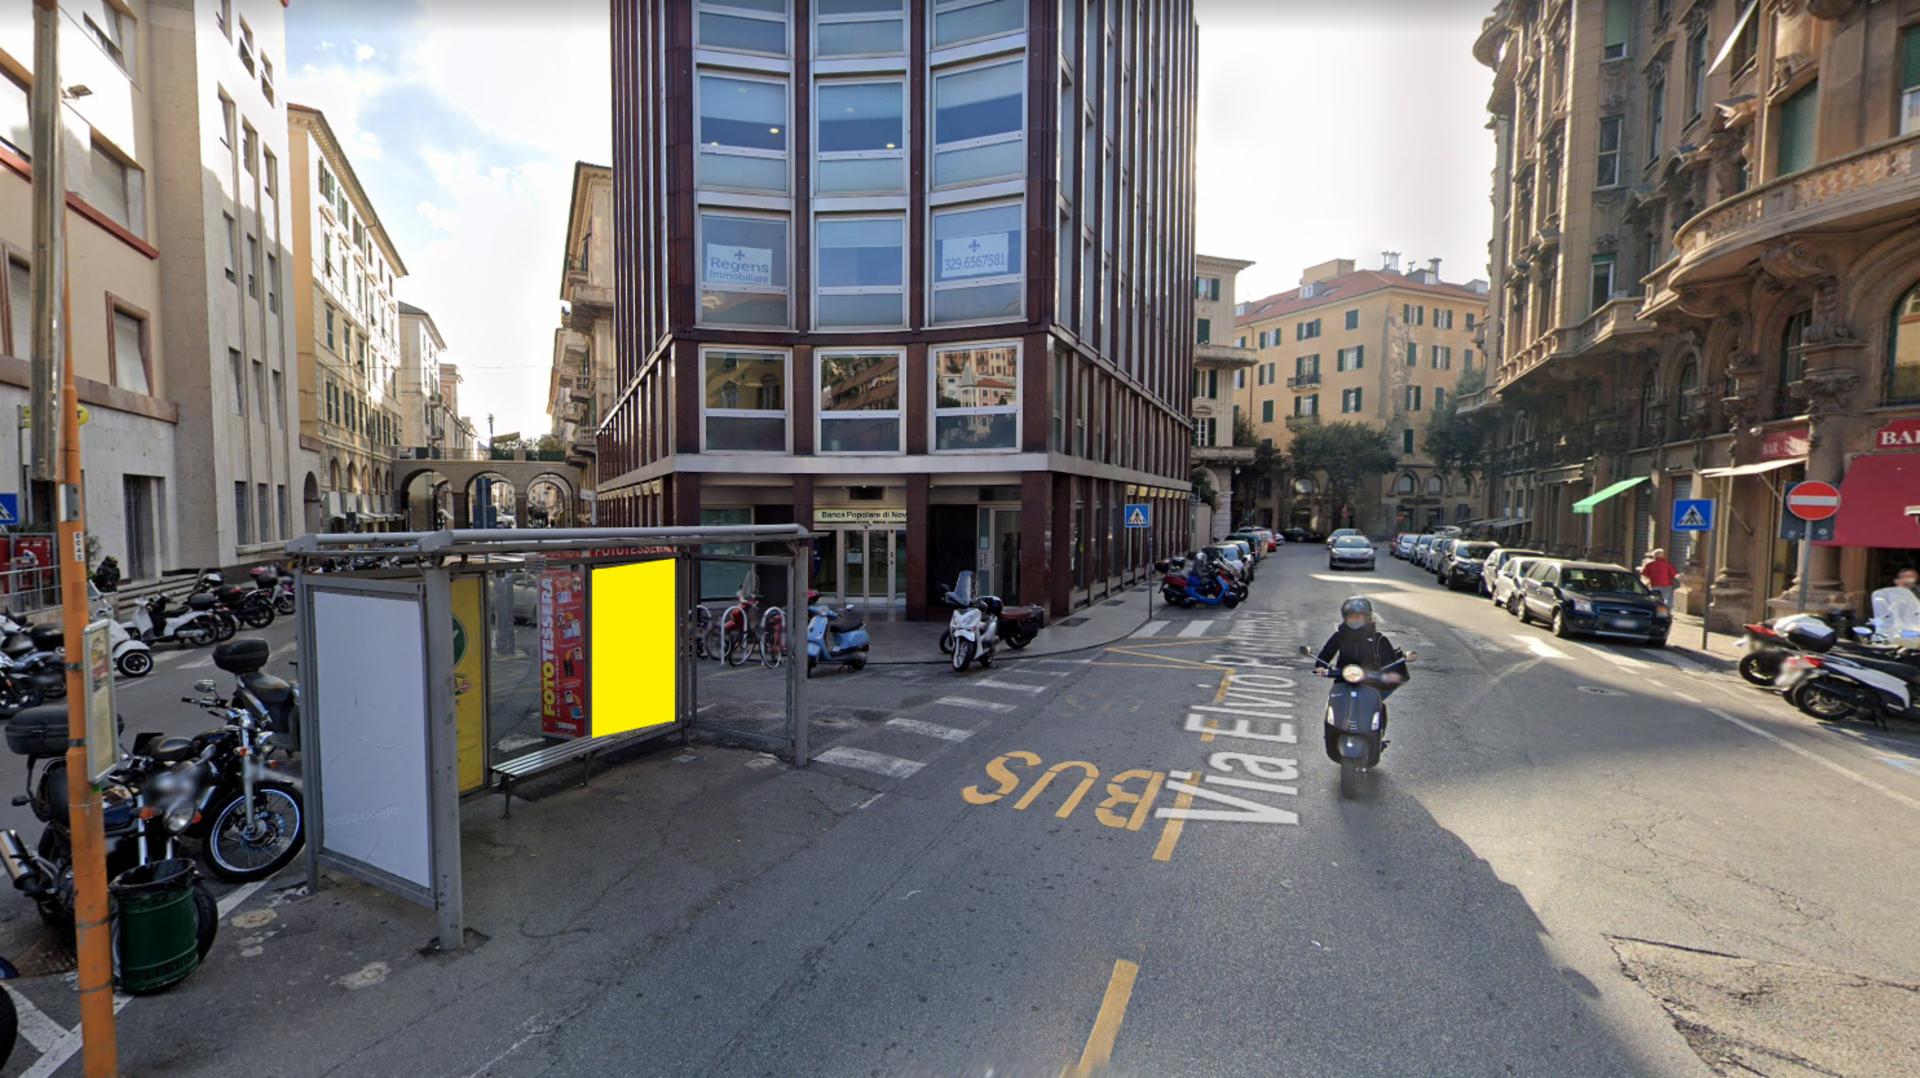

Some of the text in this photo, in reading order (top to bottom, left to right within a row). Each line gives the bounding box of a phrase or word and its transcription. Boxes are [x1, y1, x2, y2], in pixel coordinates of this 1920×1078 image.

[709, 256, 769, 273] Regens
[944, 253, 1005, 271] 329.6567581
[821, 511, 845, 519] Banca
[846, 511, 881, 520] Popolare
[882, 511, 890, 519] di
[961, 750, 1166, 831] BUS
